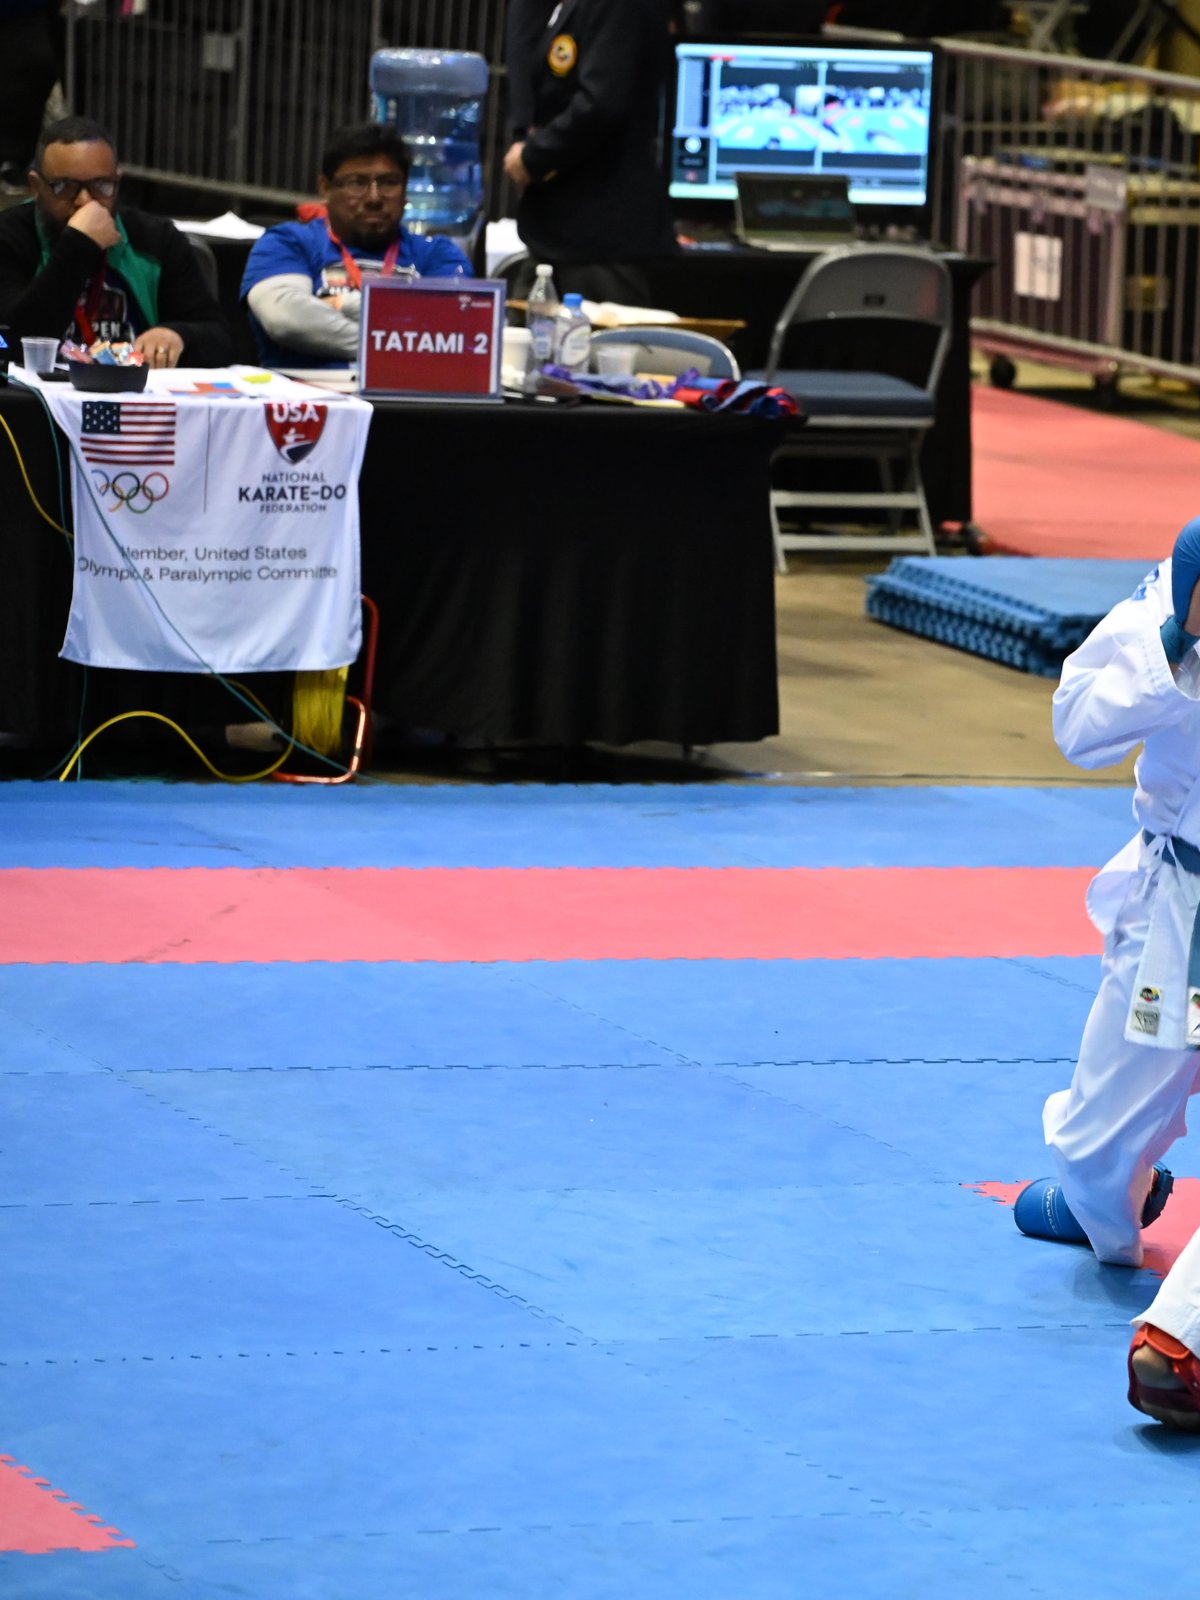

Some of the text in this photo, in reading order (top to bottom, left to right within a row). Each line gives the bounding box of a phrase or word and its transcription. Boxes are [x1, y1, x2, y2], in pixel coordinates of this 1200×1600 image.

[371, 330, 488, 355] TATAMI 2
[271, 400, 321, 423] USA
[261, 471, 326, 484] NATIONAL
[238, 484, 347, 503] KARATE-DO
[259, 503, 328, 514] FEDERATION
[194, 546, 250, 561] United
[254, 545, 308, 560] States
[143, 566, 153, 580] &
[159, 566, 253, 584] Paralympic
